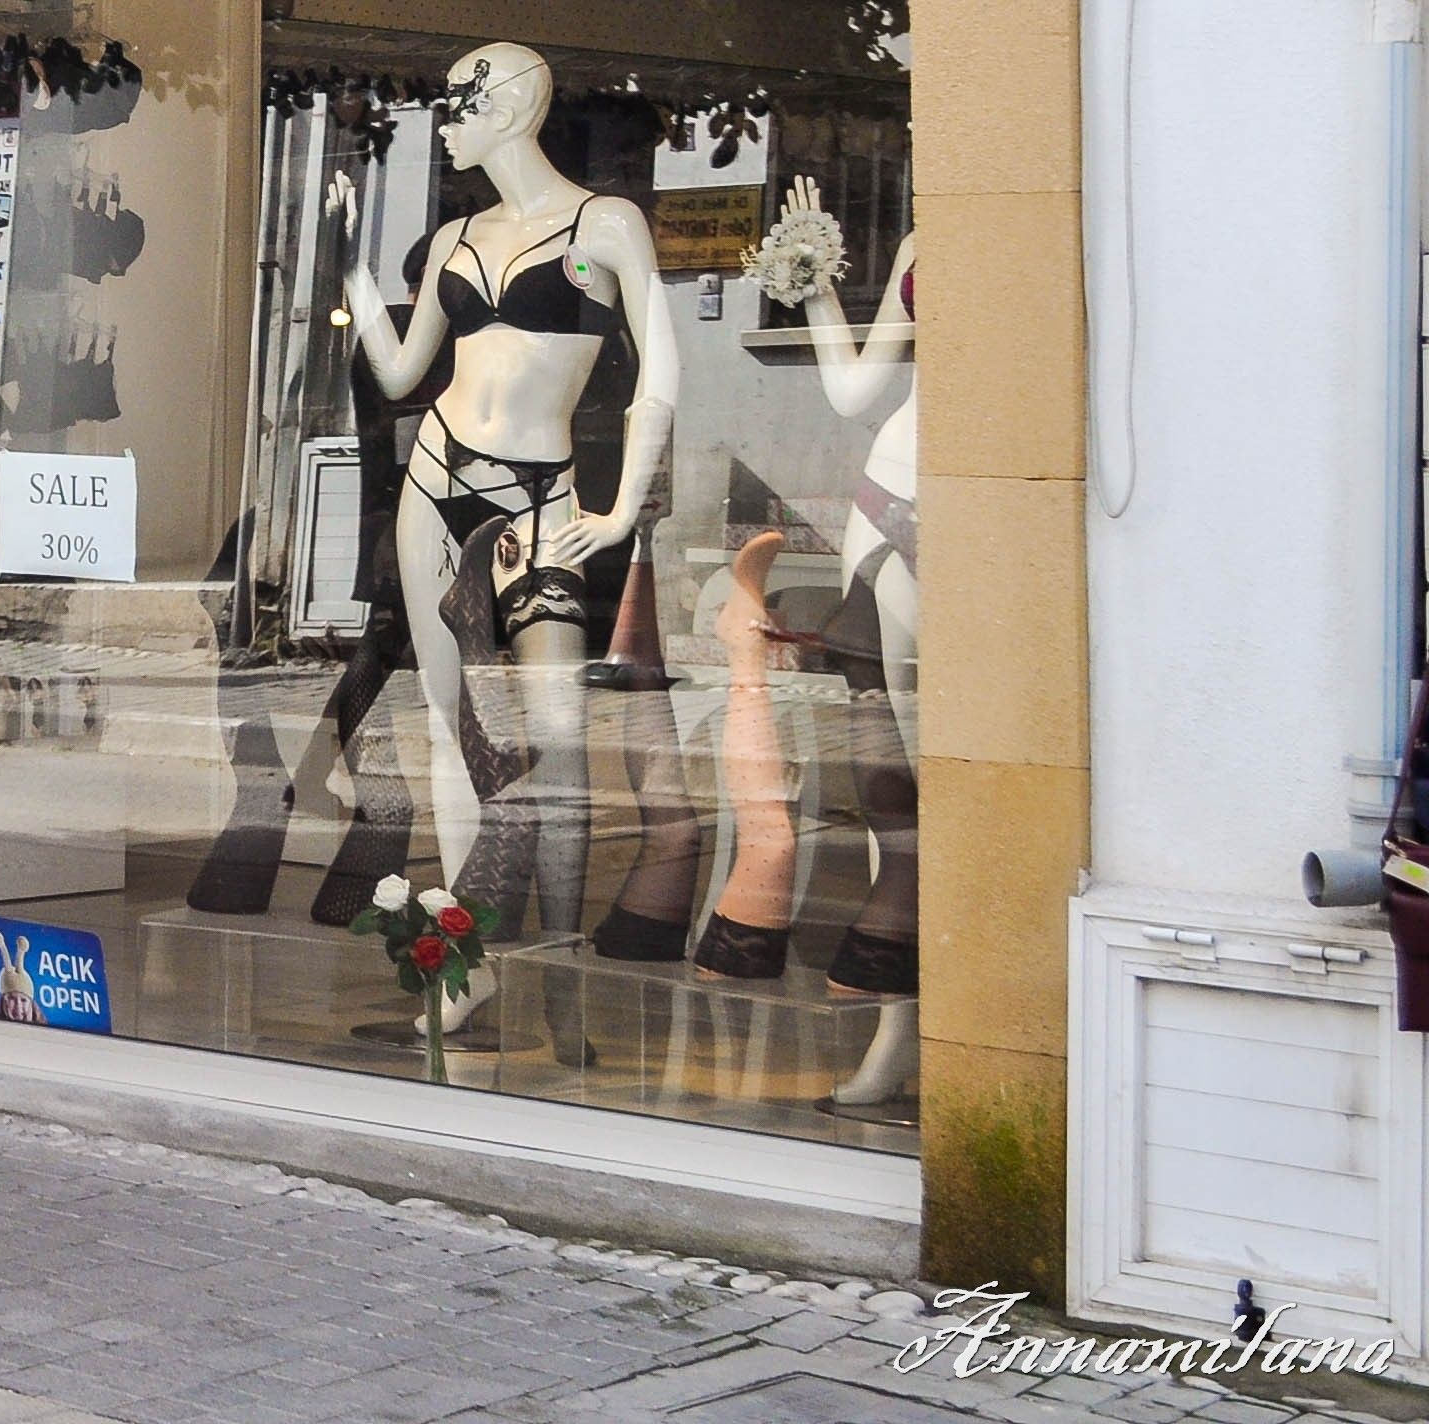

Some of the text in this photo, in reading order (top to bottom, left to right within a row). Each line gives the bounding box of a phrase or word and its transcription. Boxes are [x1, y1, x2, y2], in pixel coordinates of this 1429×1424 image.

[29, 472, 108, 508] SALE
[41, 532, 99, 565] 30%
[38, 950, 97, 984] AÇIK
[39, 985, 101, 1015] OPEN
